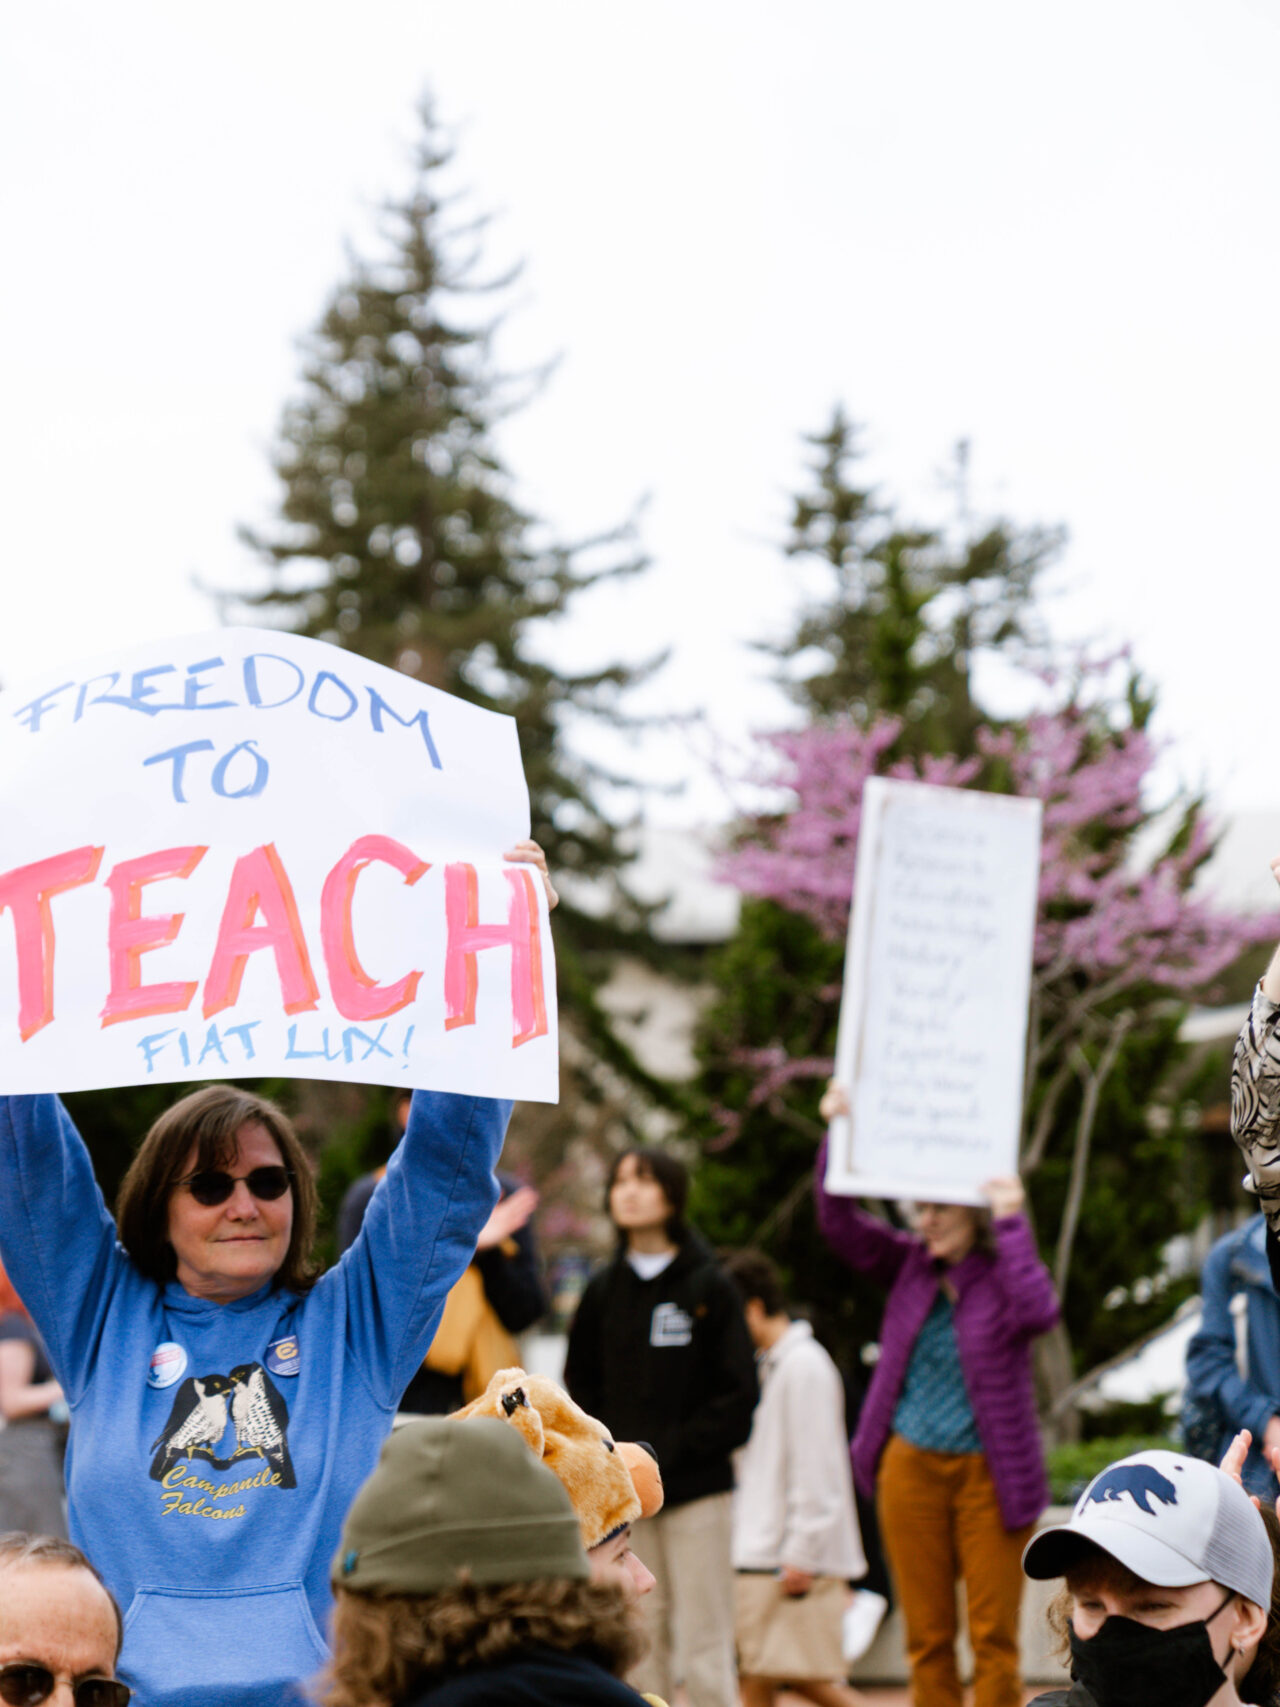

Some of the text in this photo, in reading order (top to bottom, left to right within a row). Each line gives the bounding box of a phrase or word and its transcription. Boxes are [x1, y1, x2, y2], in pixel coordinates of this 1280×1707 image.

[13, 653, 443, 770] FREEDOM
[143, 739, 270, 804] TO
[137, 1021, 413, 1073] FIAT LUX!
[160, 1492, 247, 1520] Falcons
[161, 1466, 282, 1500] Campanile
